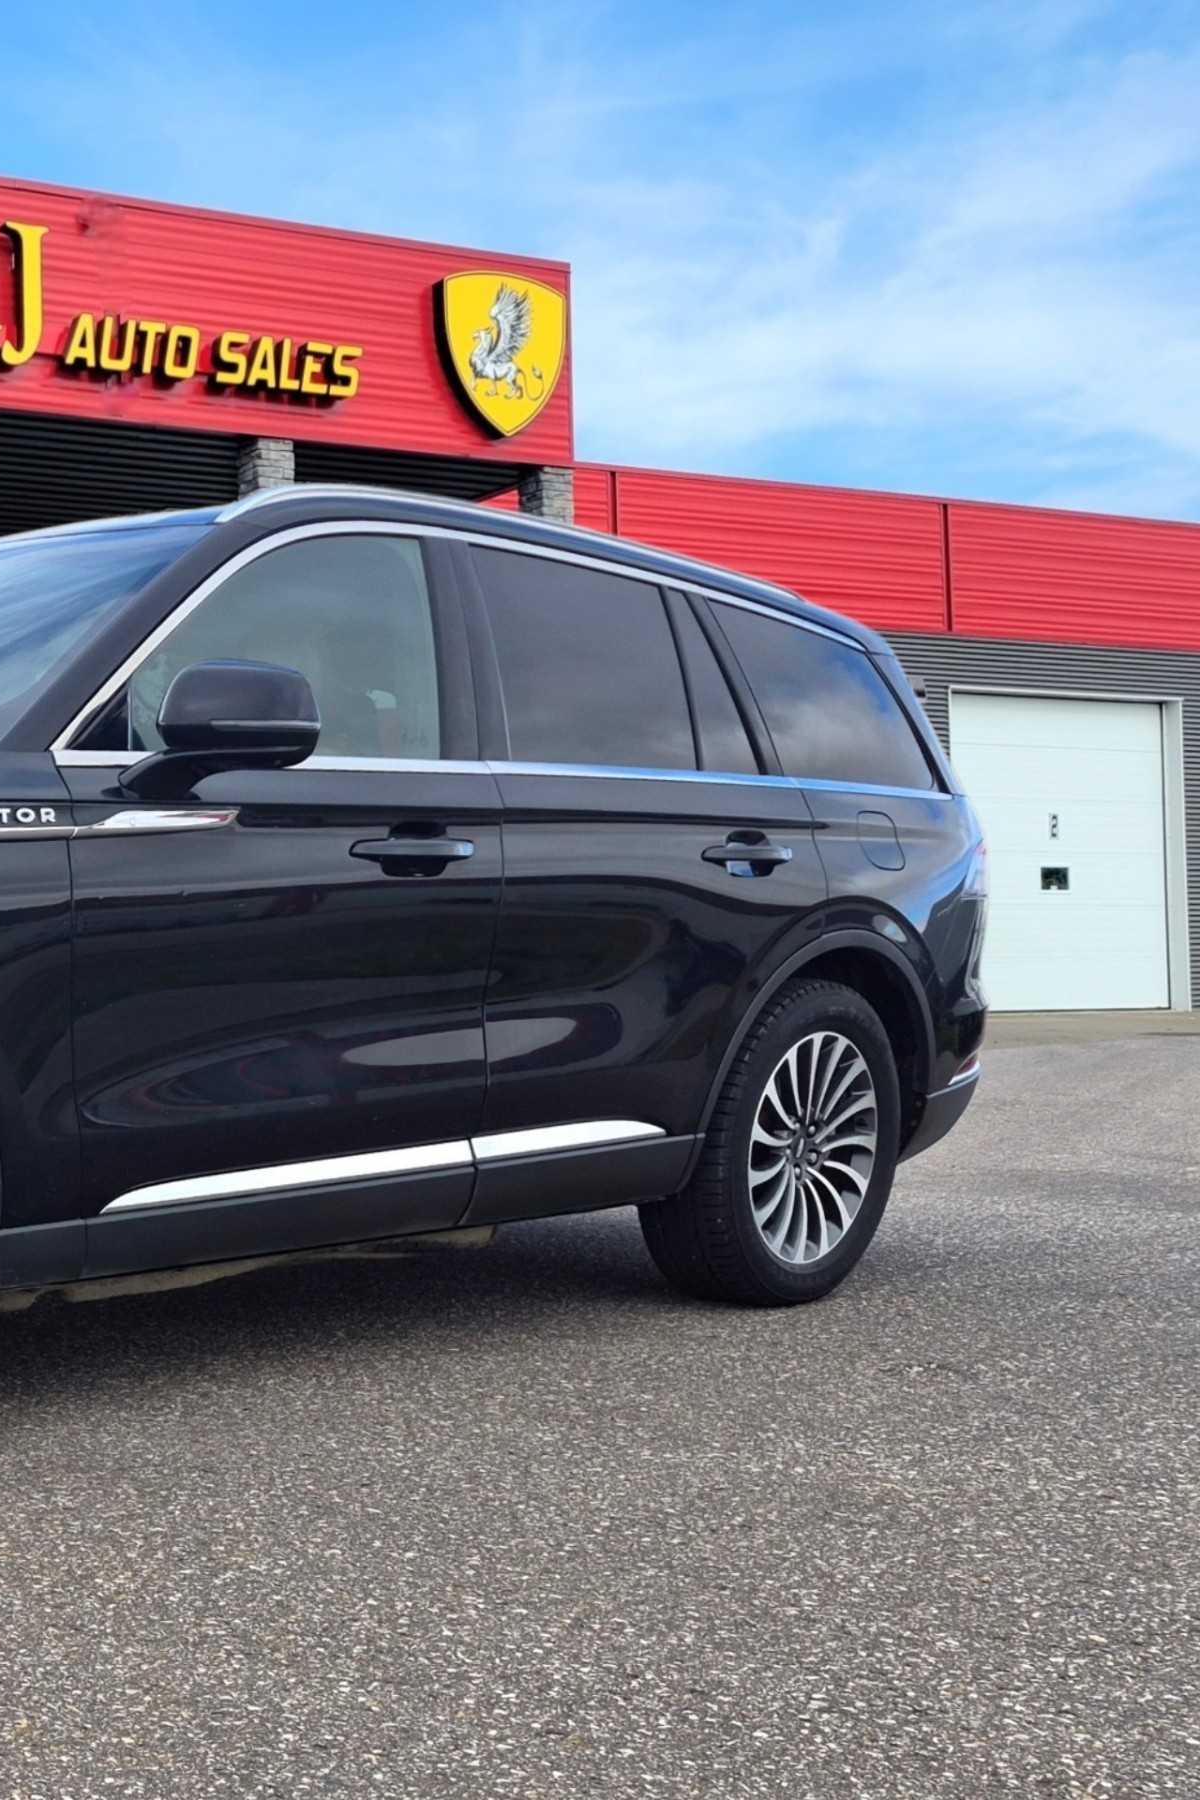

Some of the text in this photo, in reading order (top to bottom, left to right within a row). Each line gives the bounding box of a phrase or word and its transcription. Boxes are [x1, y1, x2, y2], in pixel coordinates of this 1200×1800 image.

[64, 312, 200, 380] AUTO
[215, 330, 364, 398] SALES
[1050, 814, 1058, 838] 2
